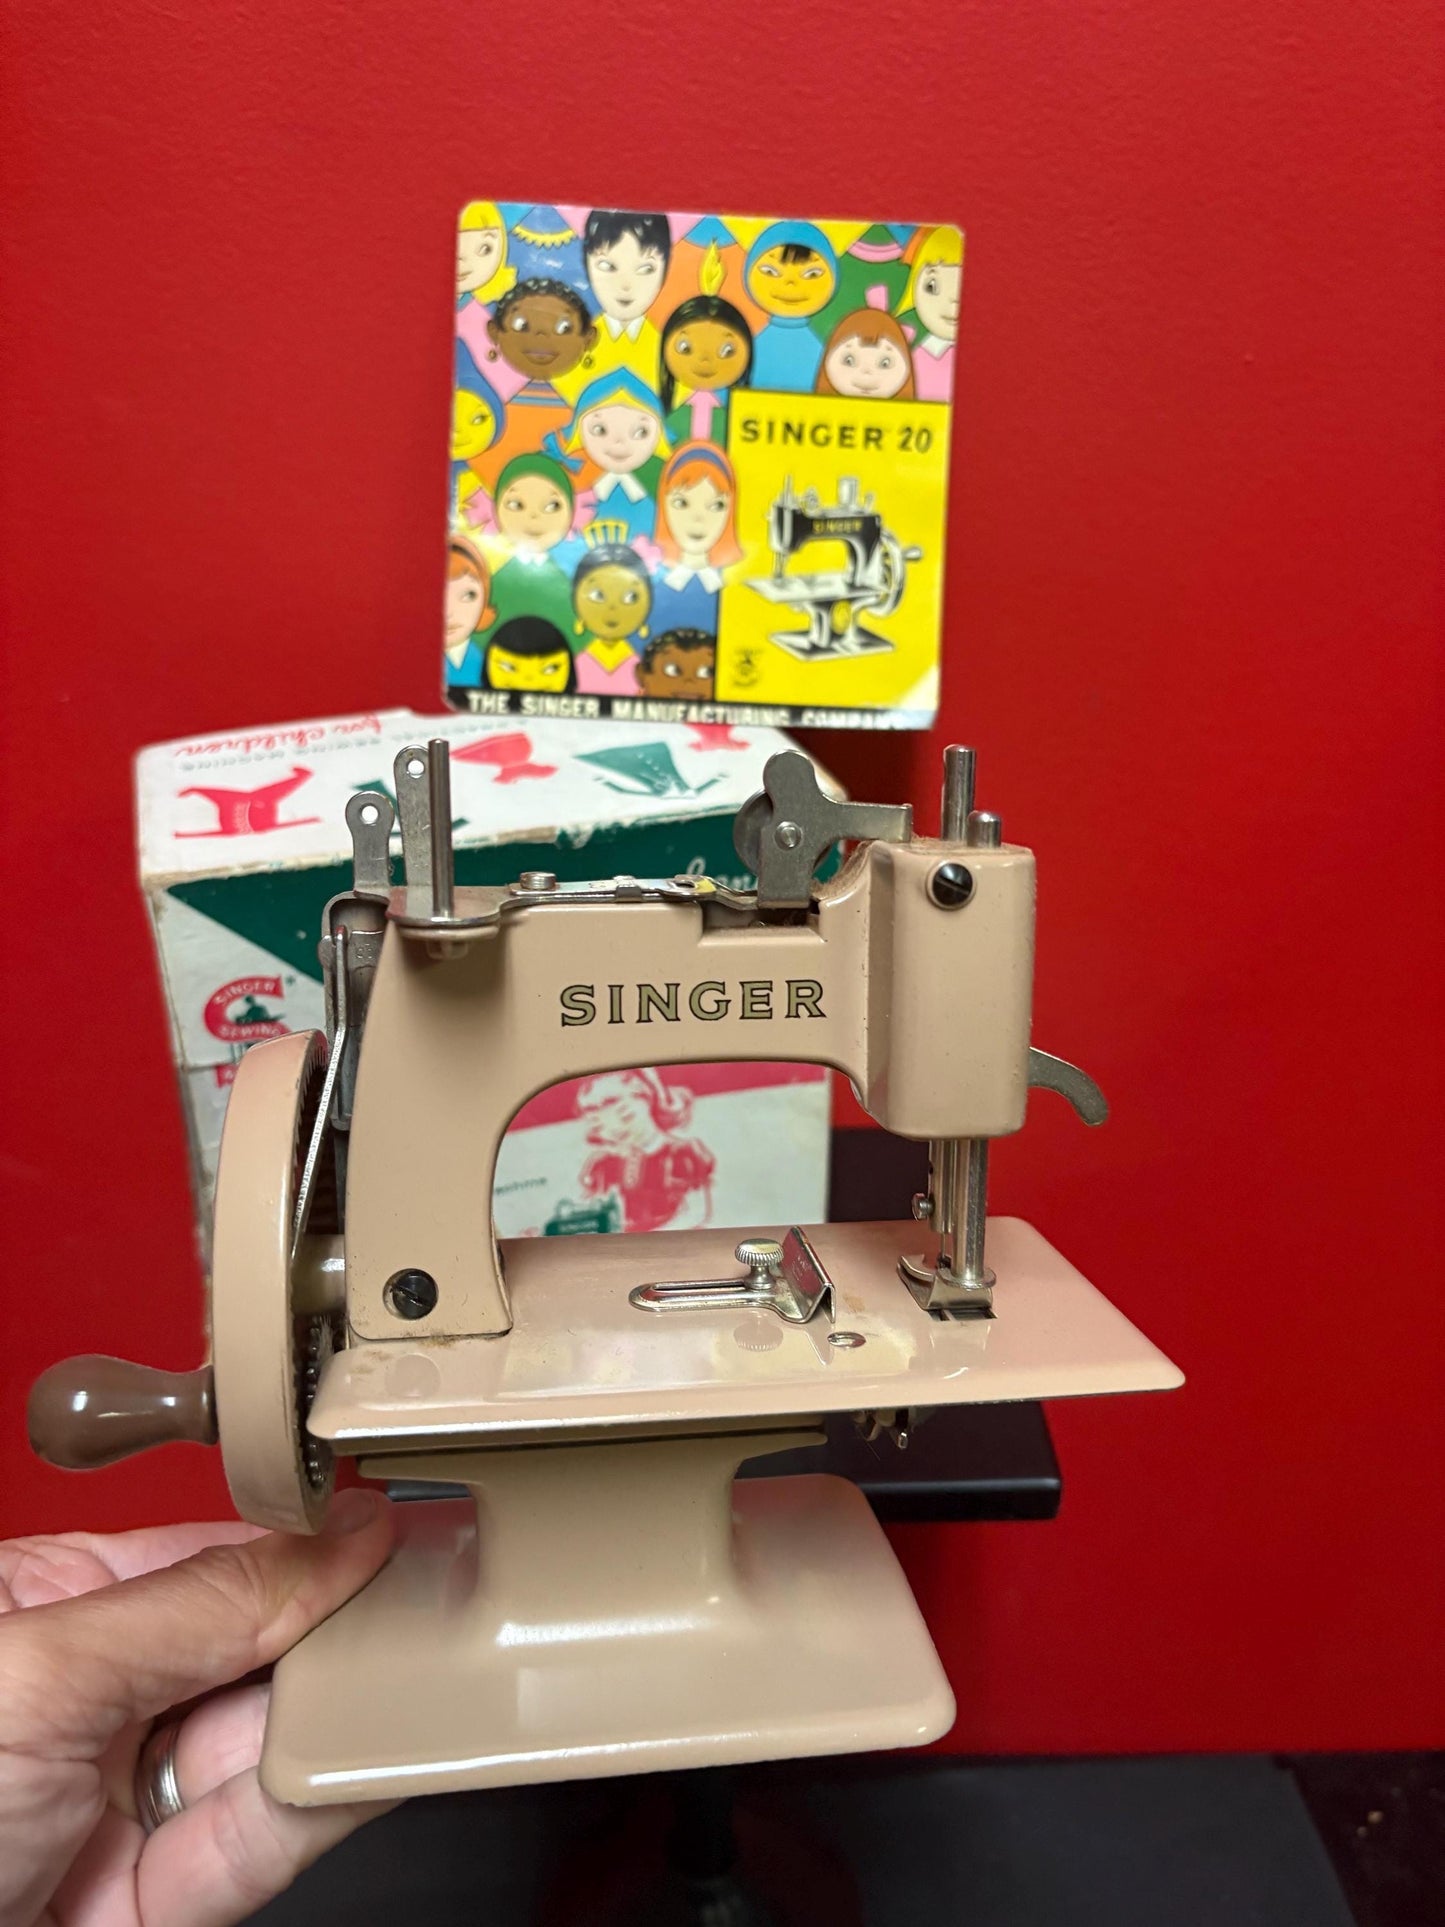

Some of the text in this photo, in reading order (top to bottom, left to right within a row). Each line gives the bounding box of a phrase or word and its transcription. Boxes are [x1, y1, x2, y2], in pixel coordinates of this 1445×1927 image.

[741, 419, 933, 453] SINGER 20
[813, 521, 864, 534] SINGER
[467, 691, 910, 730] THE SINGER MANUFACTURING COMPAN
[215, 982, 275, 1004] SINGER
[560, 979, 827, 1027] SINGER
[220, 1024, 281, 1037] SEWING
